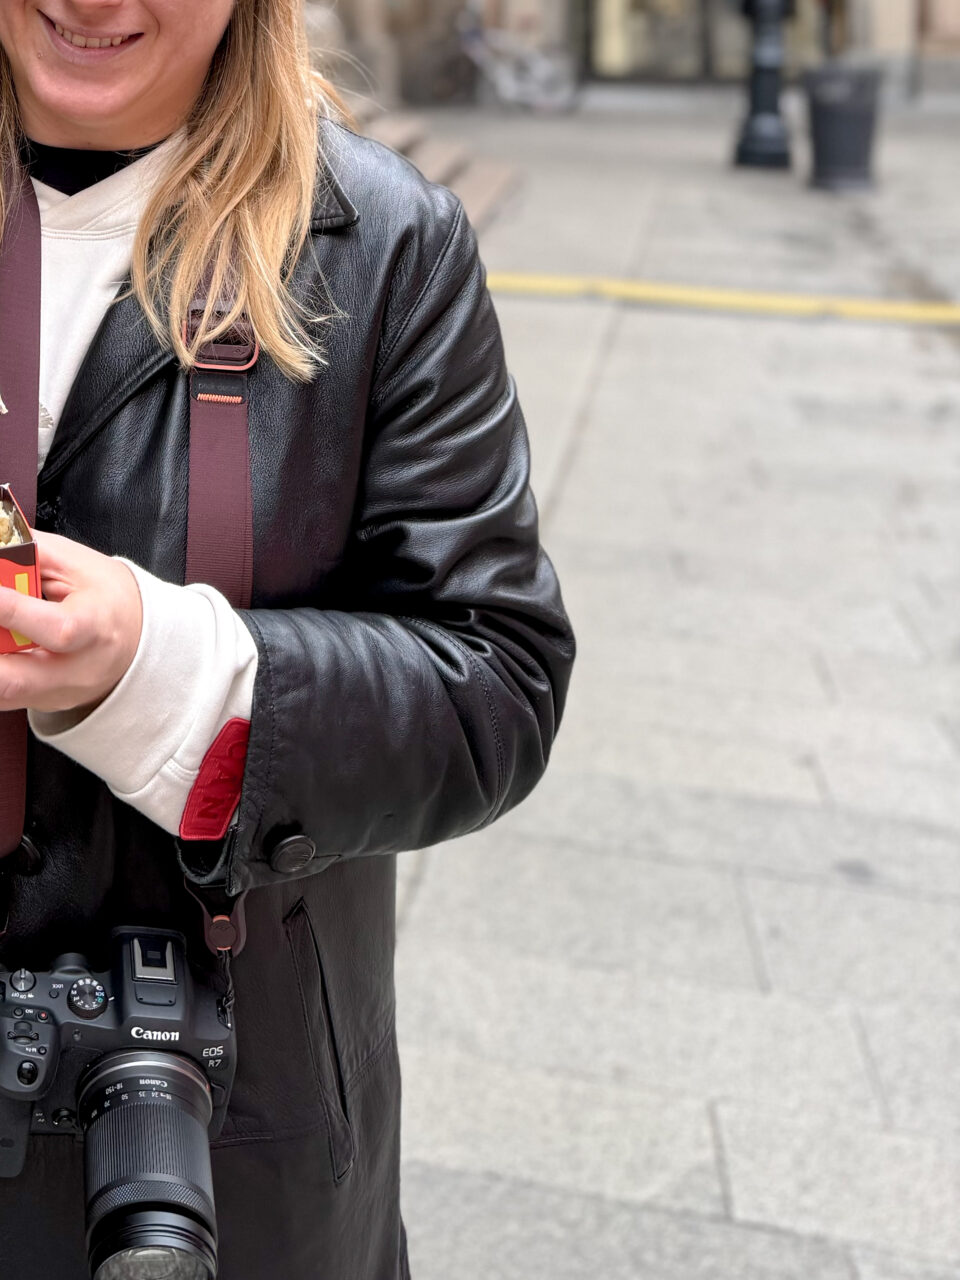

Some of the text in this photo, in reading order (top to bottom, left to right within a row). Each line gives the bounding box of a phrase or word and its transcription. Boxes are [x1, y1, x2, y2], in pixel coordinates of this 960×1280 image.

[131, 1026, 180, 1041] Canon
[202, 1046, 224, 1057] EOS
[208, 1059, 222, 1068] R7
[139, 1078, 168, 1088] Canon
[121, 1093, 129, 1101] 50
